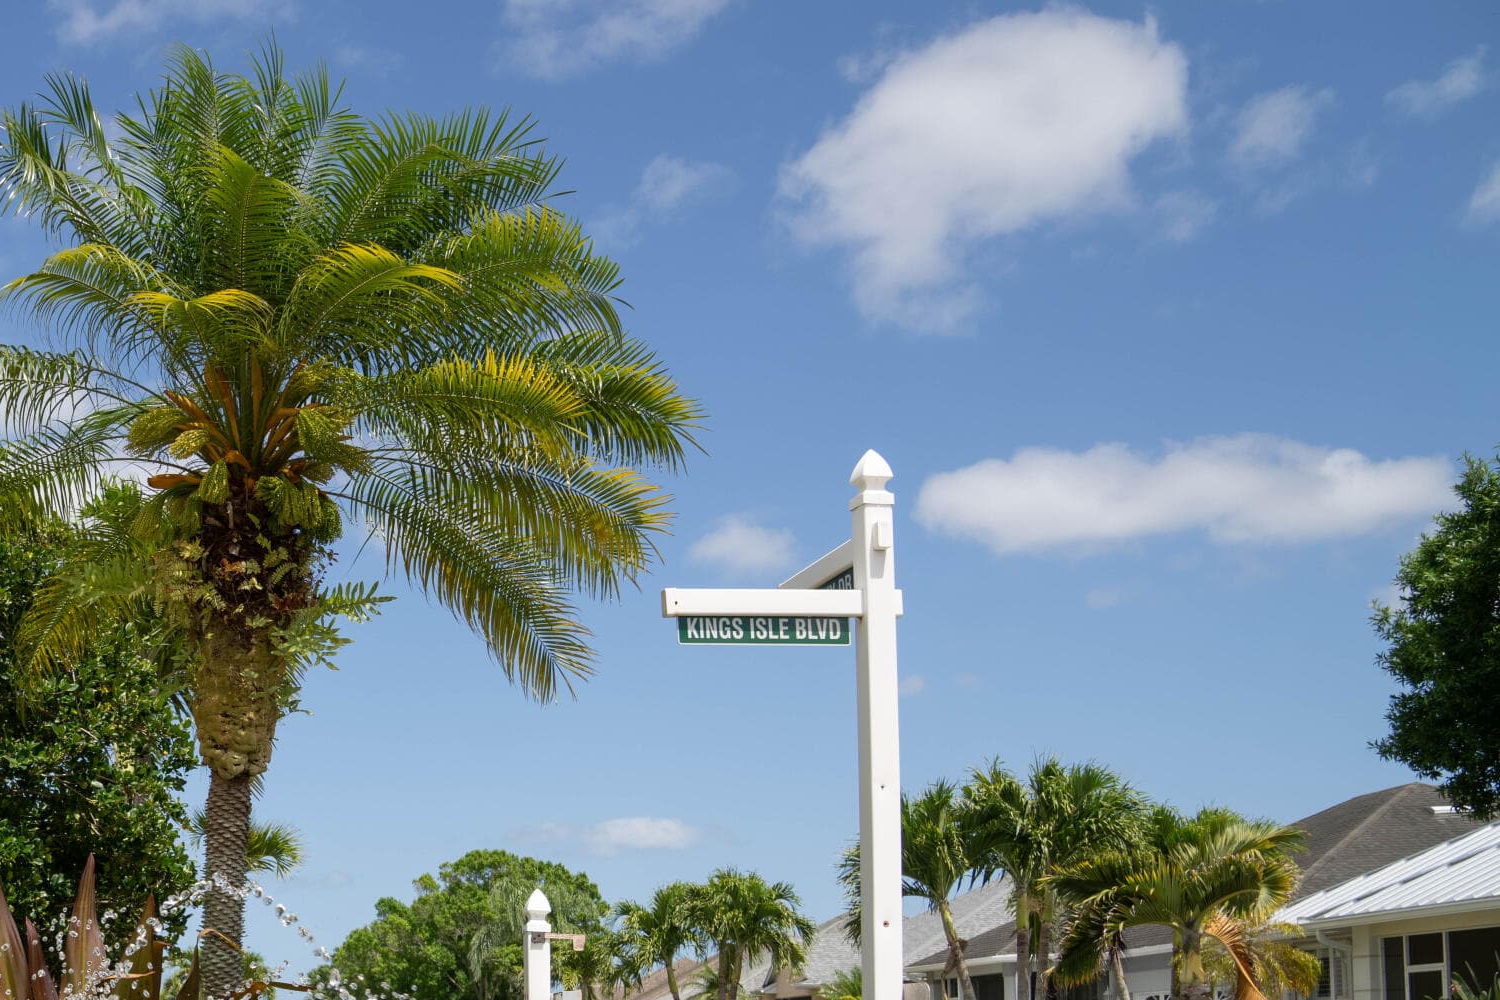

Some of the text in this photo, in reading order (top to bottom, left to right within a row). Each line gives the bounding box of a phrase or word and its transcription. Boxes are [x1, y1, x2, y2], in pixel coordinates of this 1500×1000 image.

[687, 617, 841, 640] KINGS ISLE BLVD
